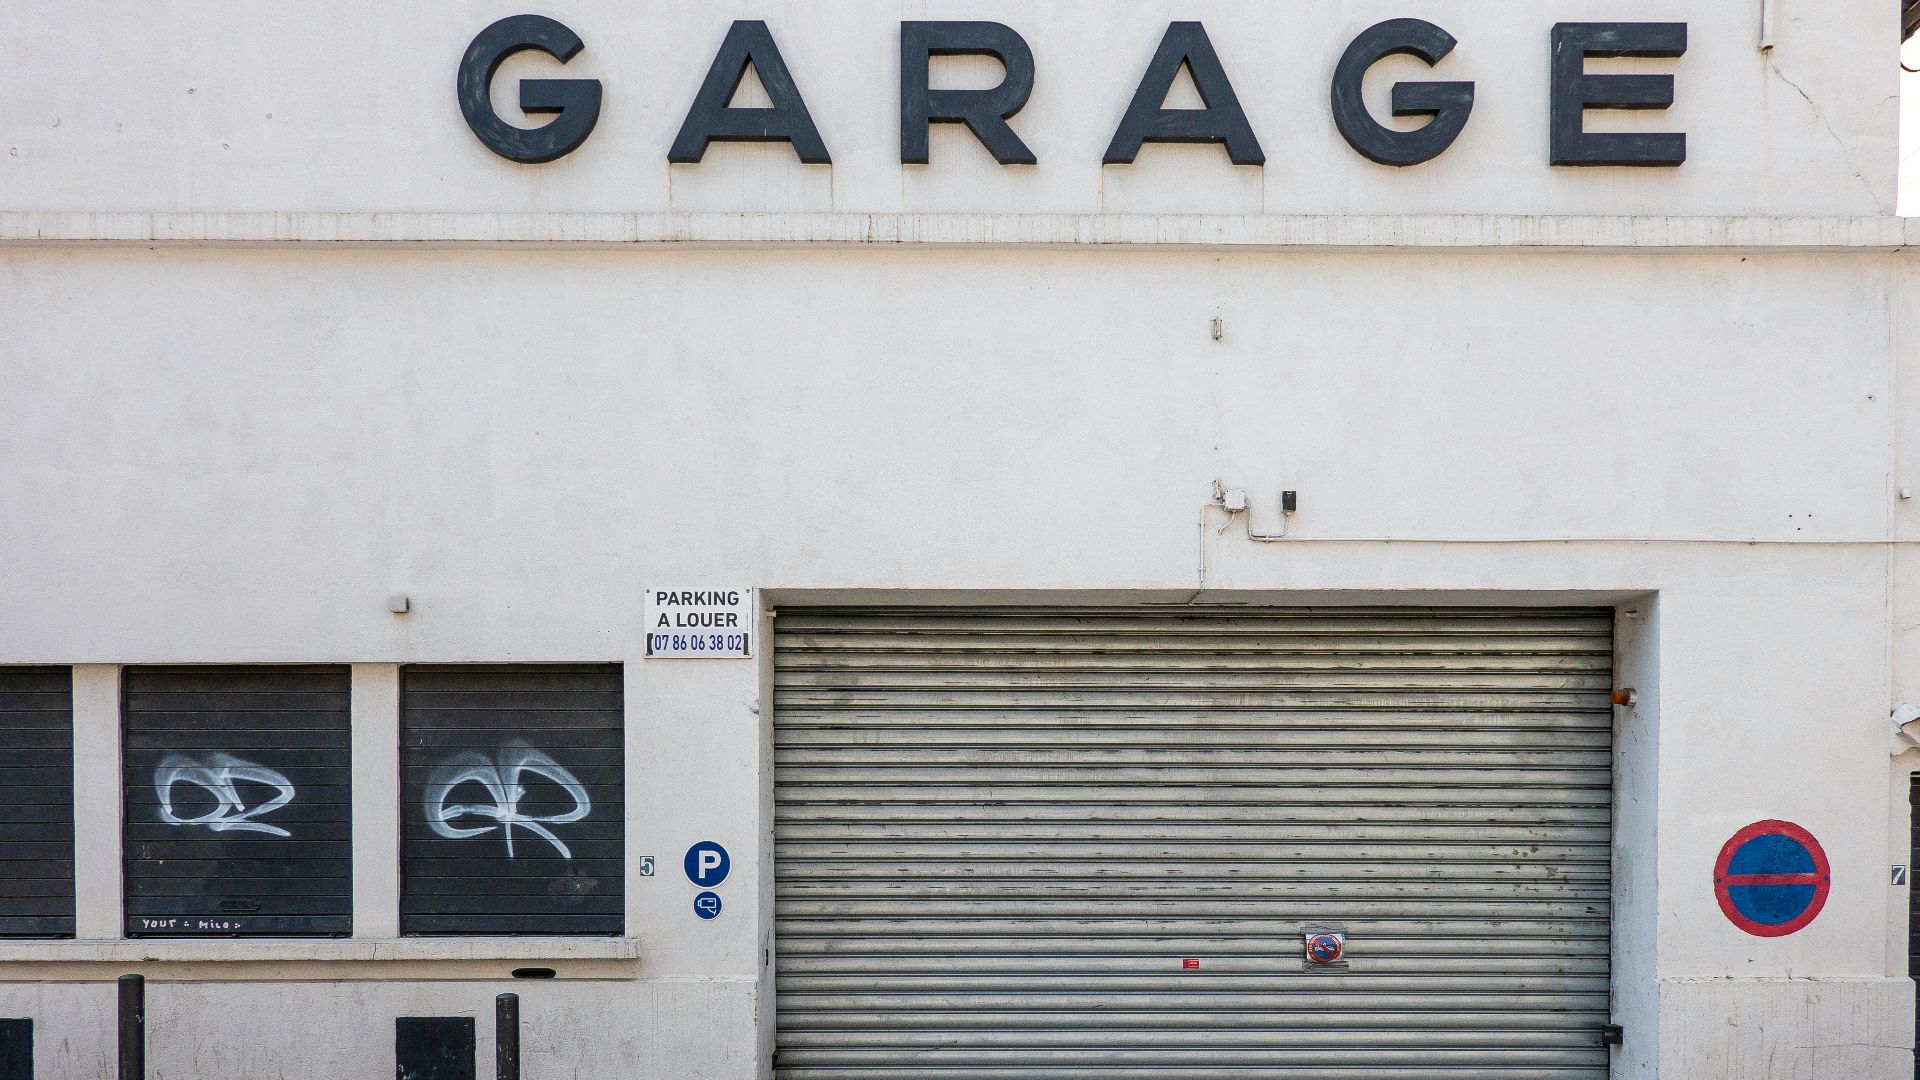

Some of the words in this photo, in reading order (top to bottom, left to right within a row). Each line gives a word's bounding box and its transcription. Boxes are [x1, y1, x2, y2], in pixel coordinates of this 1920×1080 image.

[457, 15, 1687, 167] GARAGE
[656, 591, 740, 606] PARKING
[657, 612, 670, 627] A
[676, 612, 738, 627] LOUER
[654, 634, 669, 650] 07
[672, 634, 687, 650] 86
[691, 634, 705, 650] 06
[709, 634, 724, 650] 38
[727, 634, 742, 650] 02
[640, 856, 654, 876] 5
[698, 850, 722, 879] P
[1892, 865, 1905, 885] 7
